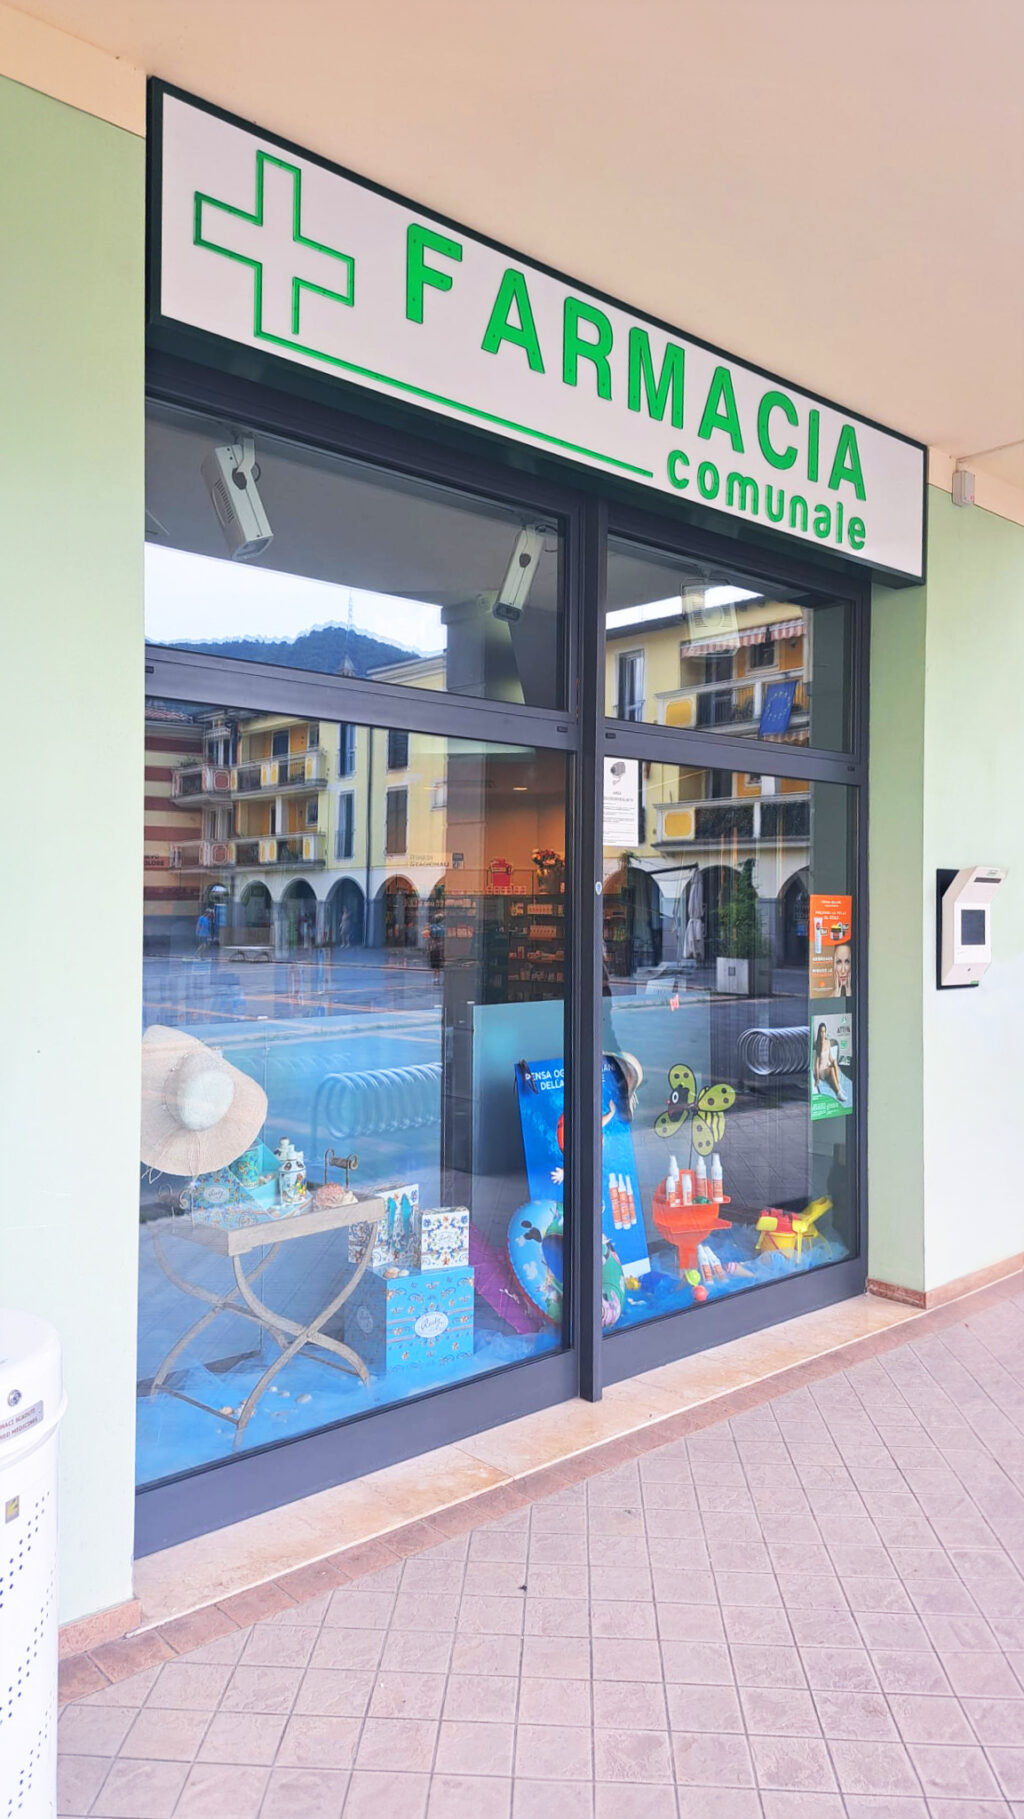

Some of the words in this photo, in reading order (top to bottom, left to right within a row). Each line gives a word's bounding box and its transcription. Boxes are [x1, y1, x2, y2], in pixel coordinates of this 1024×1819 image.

[406, 224, 866, 501] FARMACIA
[668, 450, 866, 551] comunale
[525, 1070, 552, 1081] PENSA
[541, 1080, 564, 1090] DELLA
